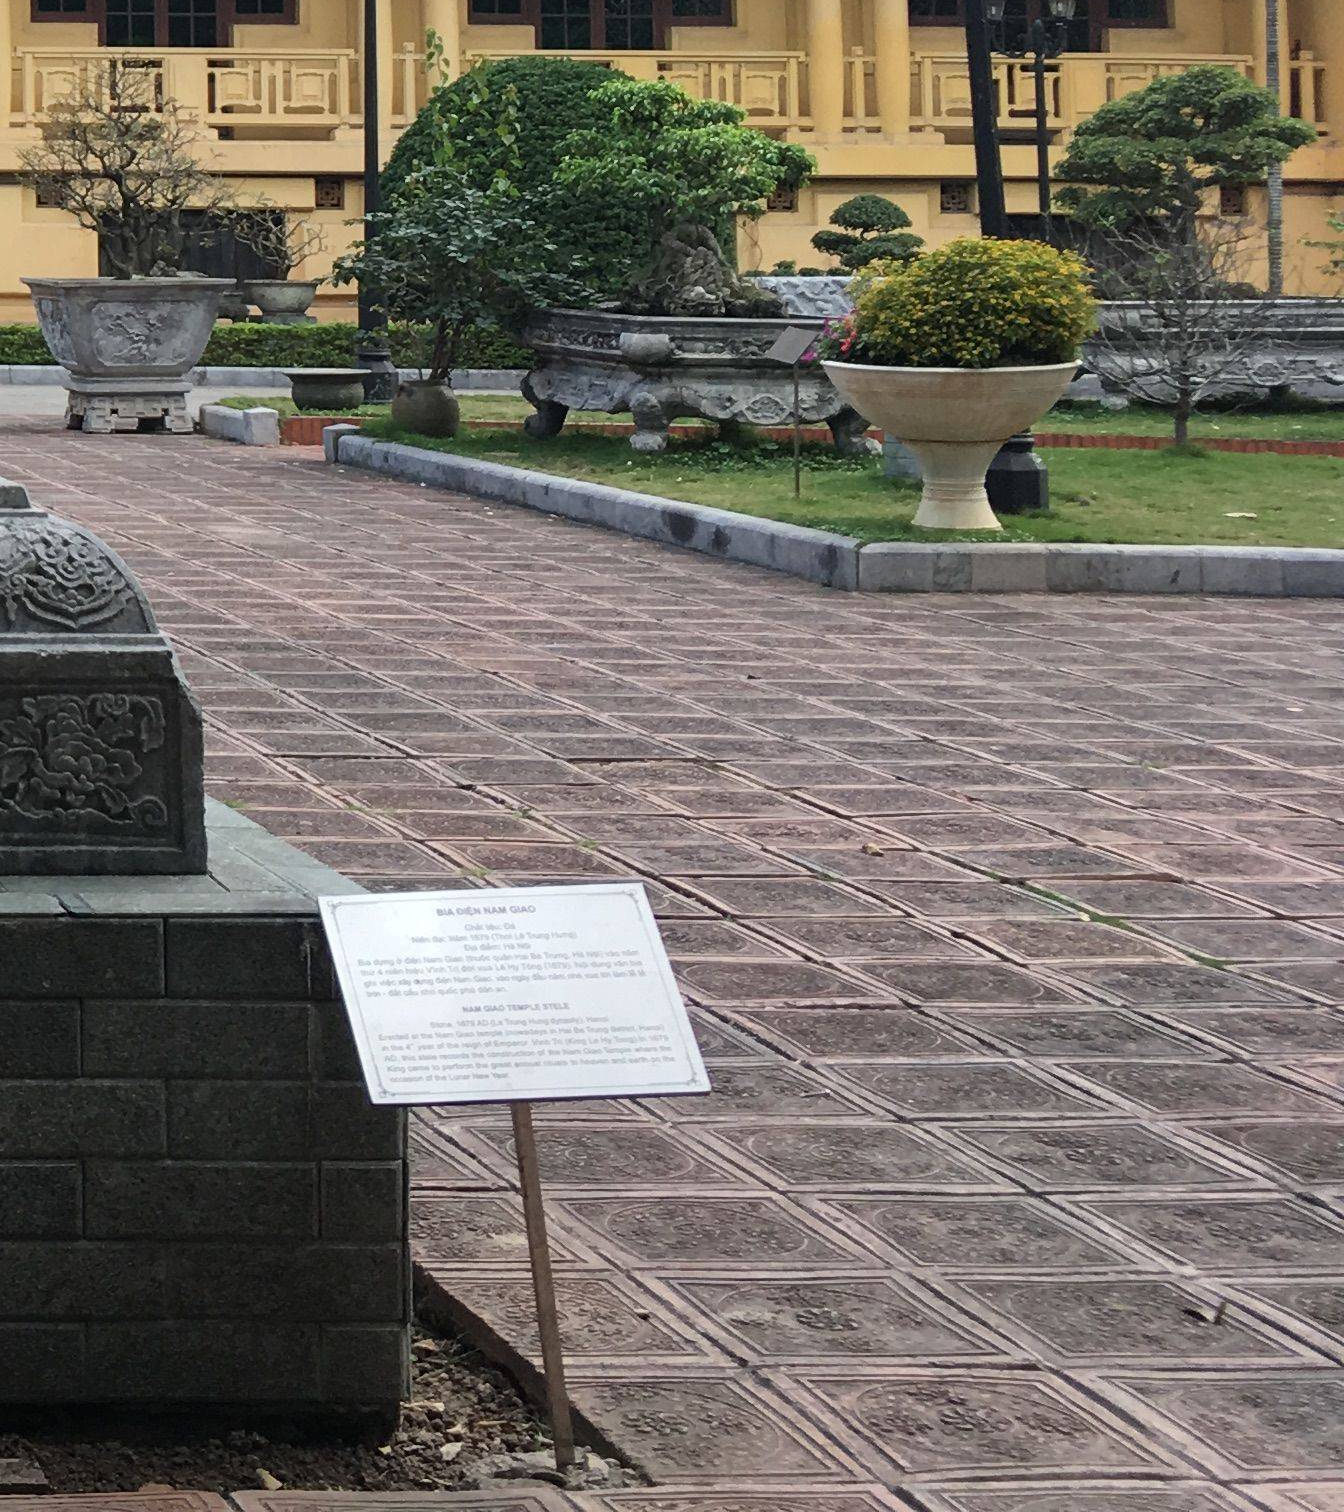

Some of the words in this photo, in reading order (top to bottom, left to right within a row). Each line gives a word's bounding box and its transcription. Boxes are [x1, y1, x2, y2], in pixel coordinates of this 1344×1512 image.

[436, 907, 454, 916] BIA
[455, 906, 480, 915] ĐIỆN
[482, 905, 506, 914] NAM
[508, 904, 536, 913] GIAO
[483, 1004, 504, 1012] GIAO
[507, 1003, 540, 1011] TEMPLE
[542, 1002, 569, 1010] STELE
